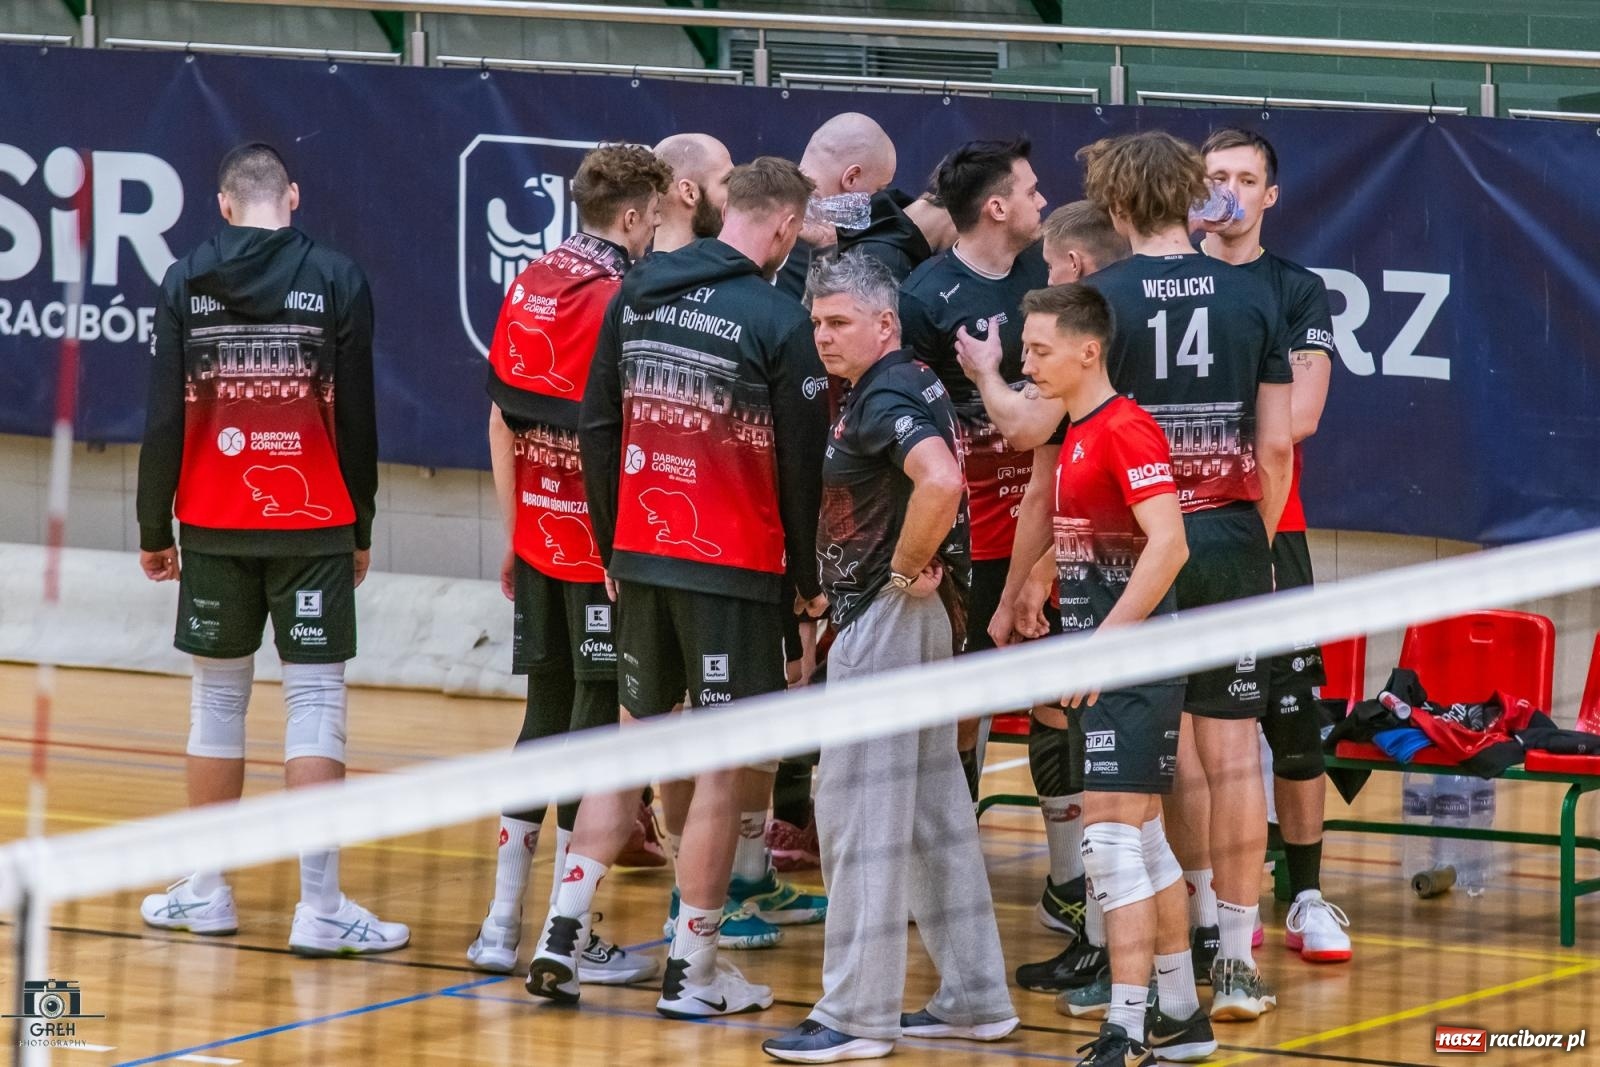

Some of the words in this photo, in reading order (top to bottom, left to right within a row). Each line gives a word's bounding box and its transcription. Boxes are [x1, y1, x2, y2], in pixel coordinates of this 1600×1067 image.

[1142, 276, 1215, 301] WĘGLICKI
[0, 293, 156, 343] RACIBÓR
[678, 308, 742, 343] GÓRNICZA
[1147, 307, 1215, 380] 14
[250, 431, 301, 441] DĄBROWA
[250, 441, 302, 451] GÓRNICZA
[651, 461, 697, 479] GÓRNICZA
